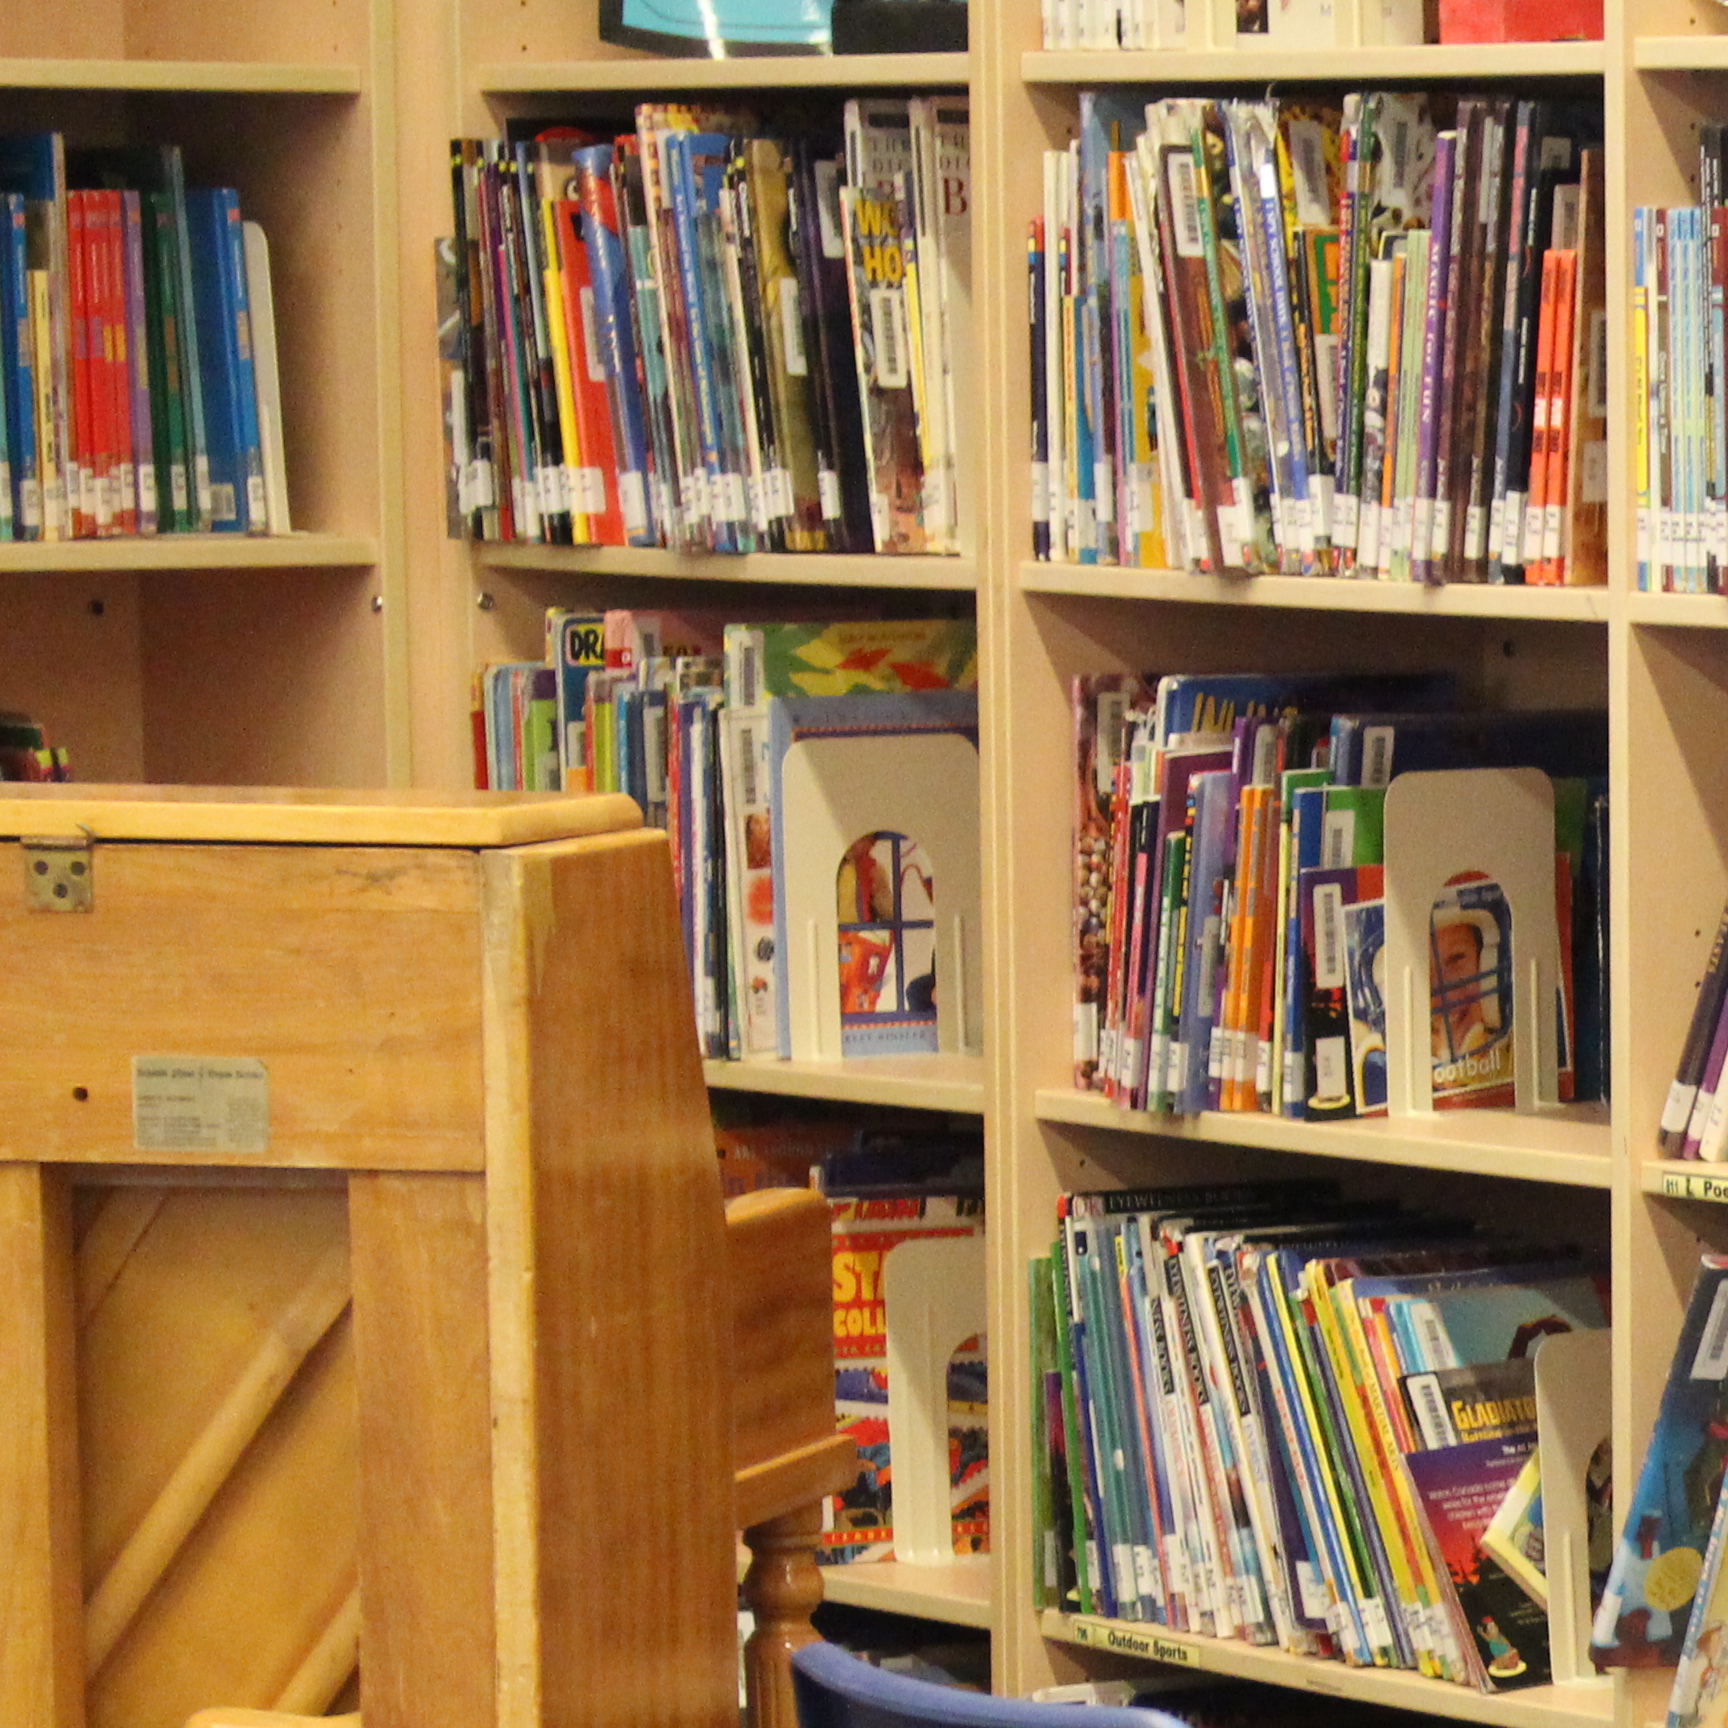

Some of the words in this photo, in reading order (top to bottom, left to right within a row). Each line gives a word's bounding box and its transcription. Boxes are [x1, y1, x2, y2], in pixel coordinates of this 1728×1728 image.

[1421, 375, 1435, 423] FUN
[1431, 1052, 1501, 1082] ootball
[1107, 1629, 1150, 1654] Outdoor
[1152, 1638, 1189, 1663] Sports
